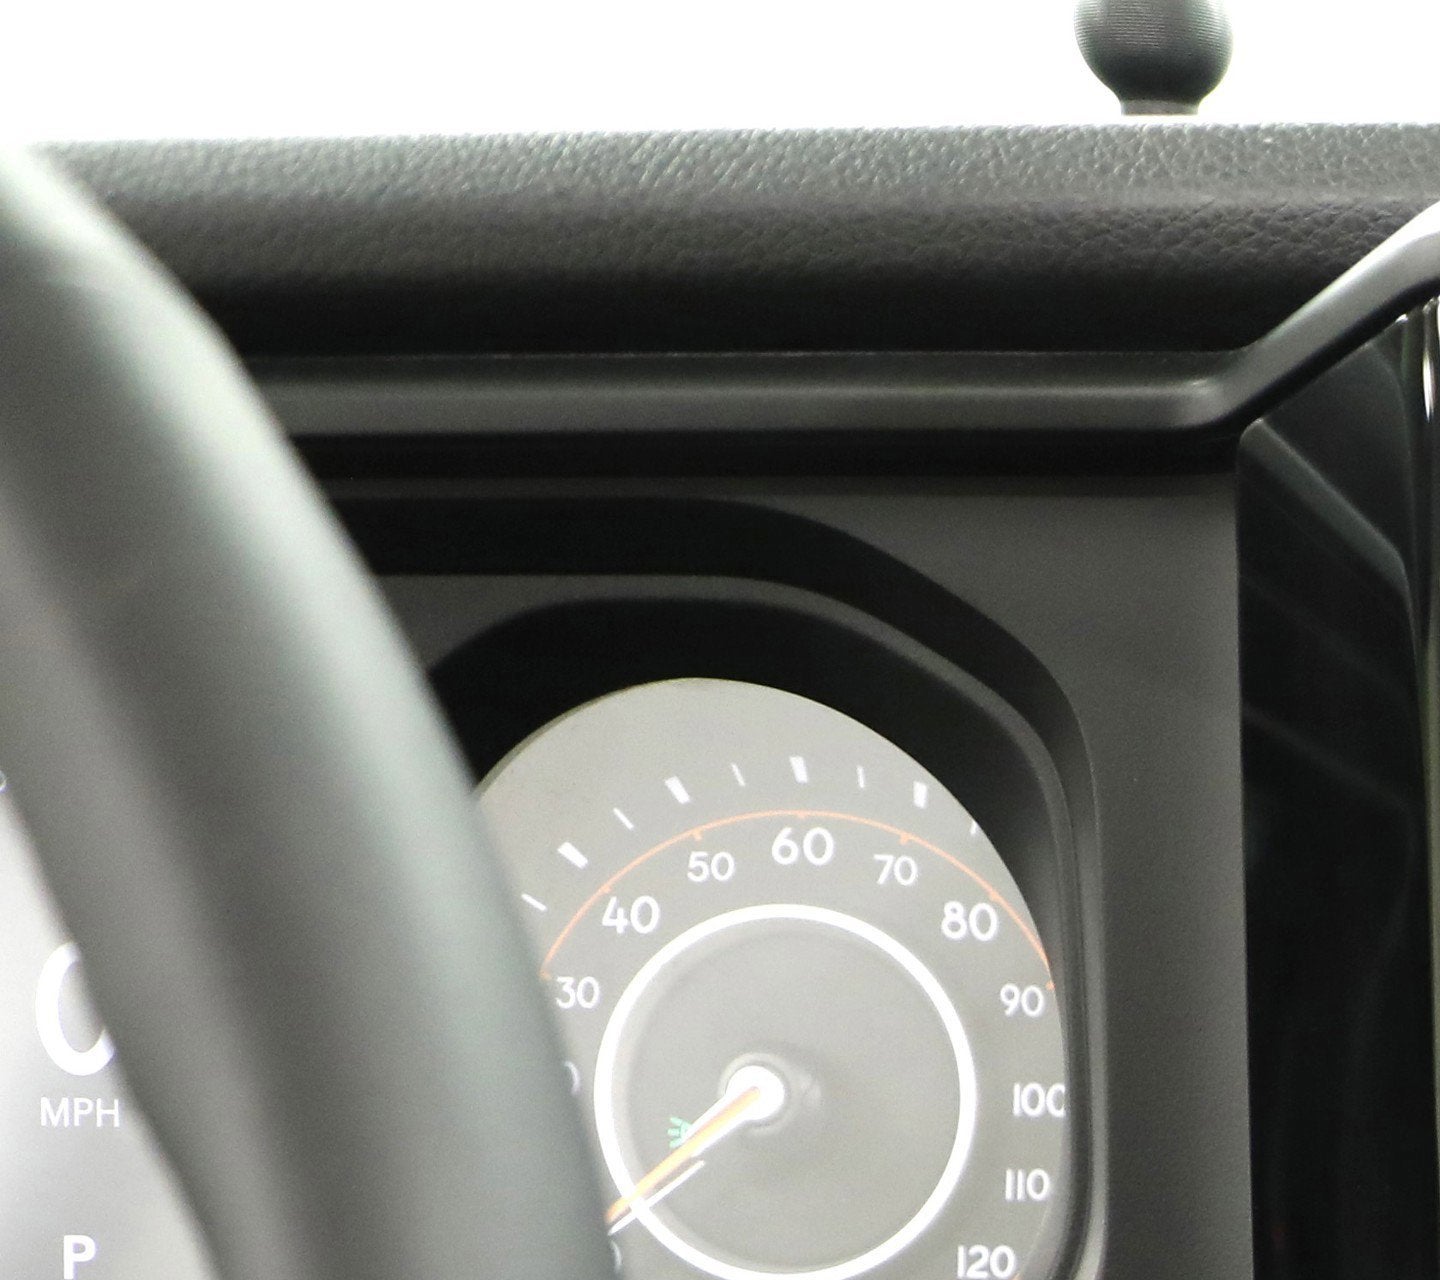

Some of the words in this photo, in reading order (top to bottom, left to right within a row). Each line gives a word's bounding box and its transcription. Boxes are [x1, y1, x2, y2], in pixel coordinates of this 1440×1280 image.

[772, 828, 833, 866] 60
[688, 850, 735, 882] 50
[874, 854, 917, 886] 70
[602, 894, 660, 934] 40
[941, 901, 998, 940] 80
[556, 977, 600, 1009] 30
[1000, 986, 1045, 1018] 90
[40, 1097, 120, 1128] MPH
[1012, 1083, 1065, 1117] 100
[1004, 1169, 1050, 1200] 110
[63, 1235, 97, 1280] P
[956, 1244, 1016, 1280] 120
